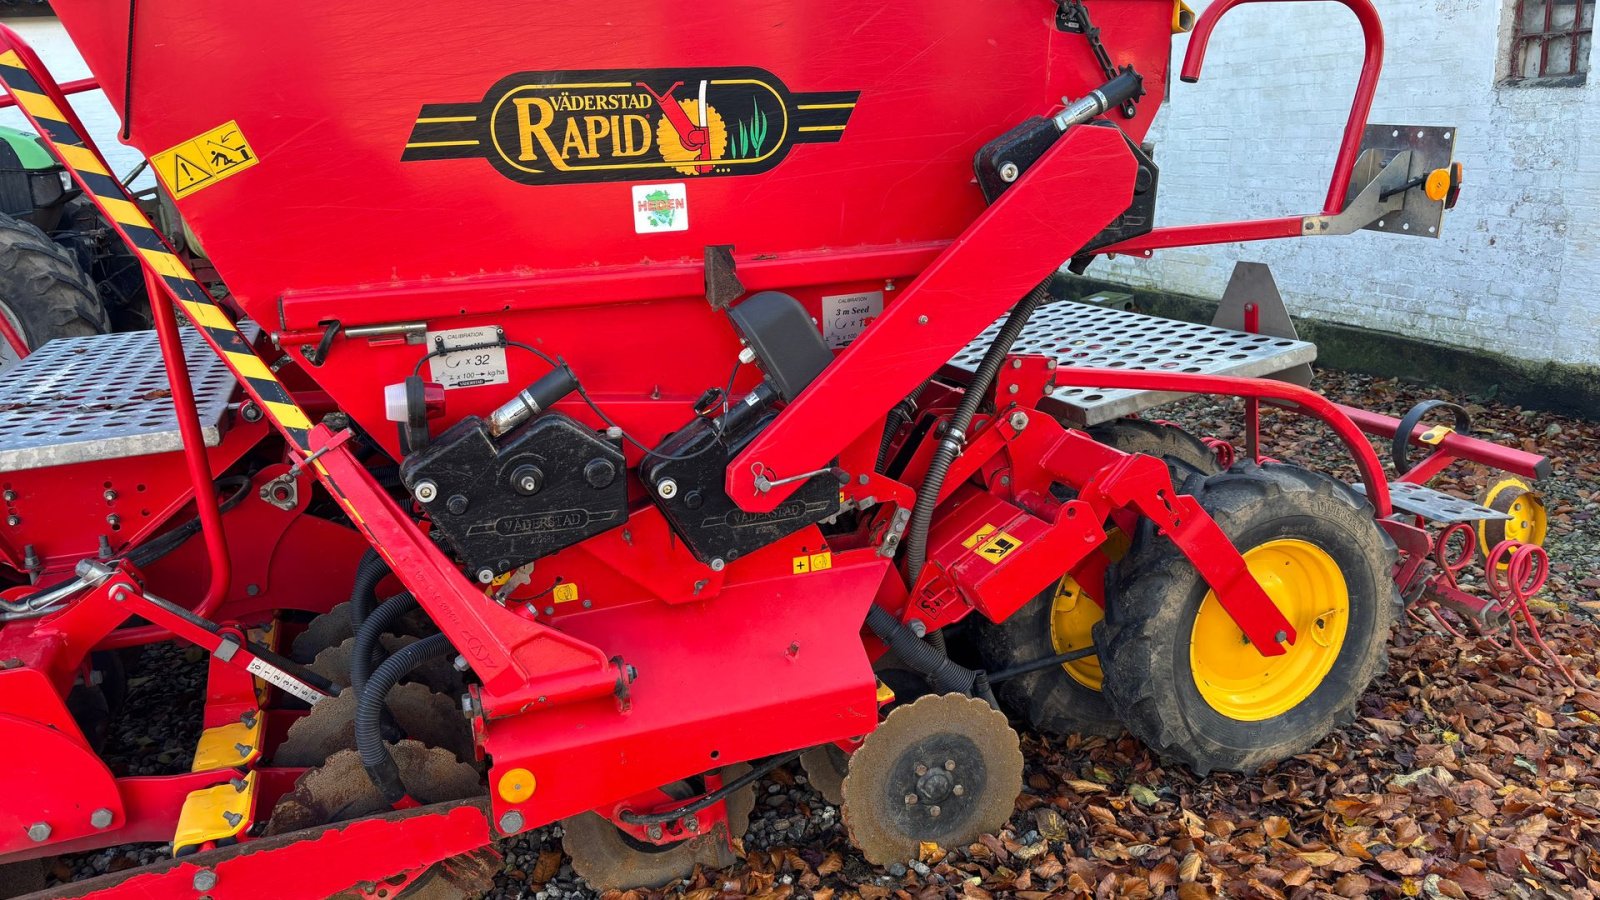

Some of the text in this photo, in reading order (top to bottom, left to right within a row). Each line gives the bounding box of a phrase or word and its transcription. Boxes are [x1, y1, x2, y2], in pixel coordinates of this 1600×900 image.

[549, 91, 653, 112] VÄDERSTAD
[637, 198, 685, 212] HEDEN
[852, 306, 870, 314] Seed
[474, 354, 490, 366] 32
[503, 513, 581, 532] VÄDERSTAD
